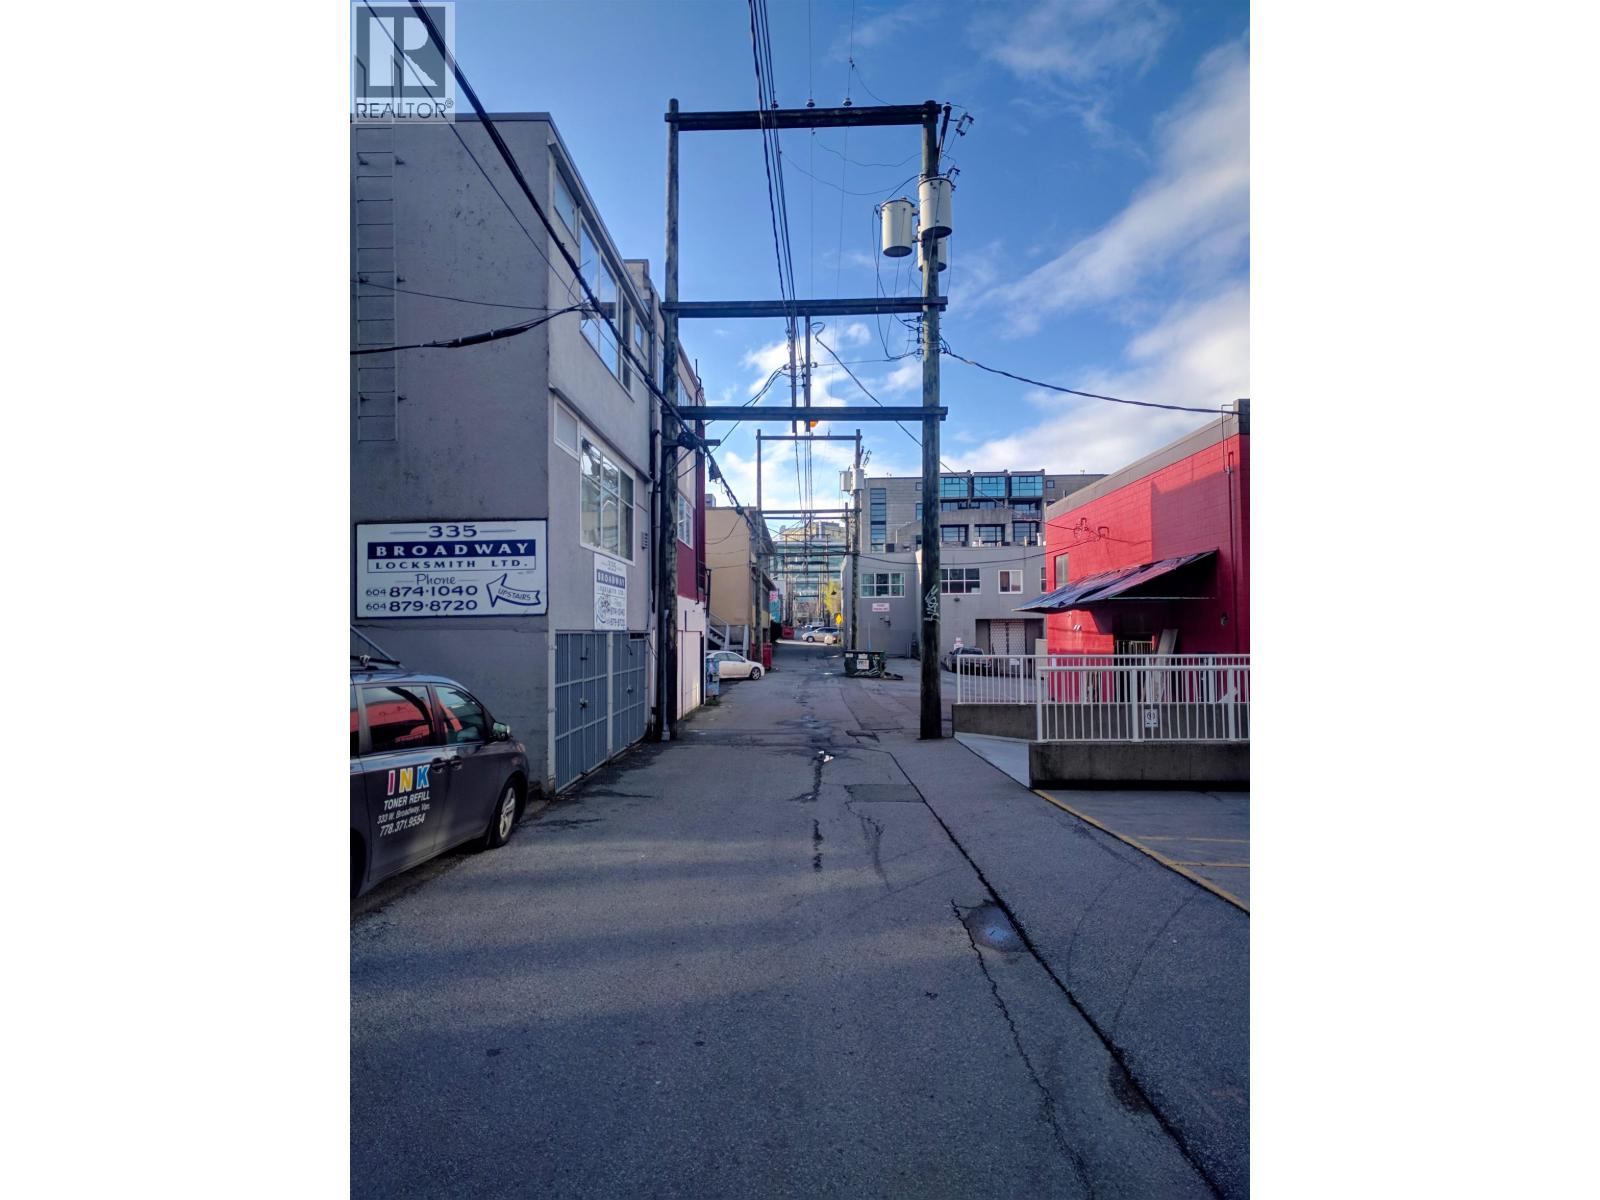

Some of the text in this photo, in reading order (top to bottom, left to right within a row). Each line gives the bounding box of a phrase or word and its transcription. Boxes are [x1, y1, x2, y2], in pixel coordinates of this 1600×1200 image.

[428, 525, 478, 538] 335
[376, 543, 528, 557] BROADWAY
[375, 559, 528, 570] LOCKSMITH LTD.
[415, 573, 456, 585] Phone
[366, 588, 386, 597] 604
[498, 588, 531, 601] UPSTAIRS
[366, 602, 386, 611] 604
[387, 764, 430, 795] INK
[383, 790, 430, 810] TONER REFILL
[380, 813, 425, 837] 778.371.9554
